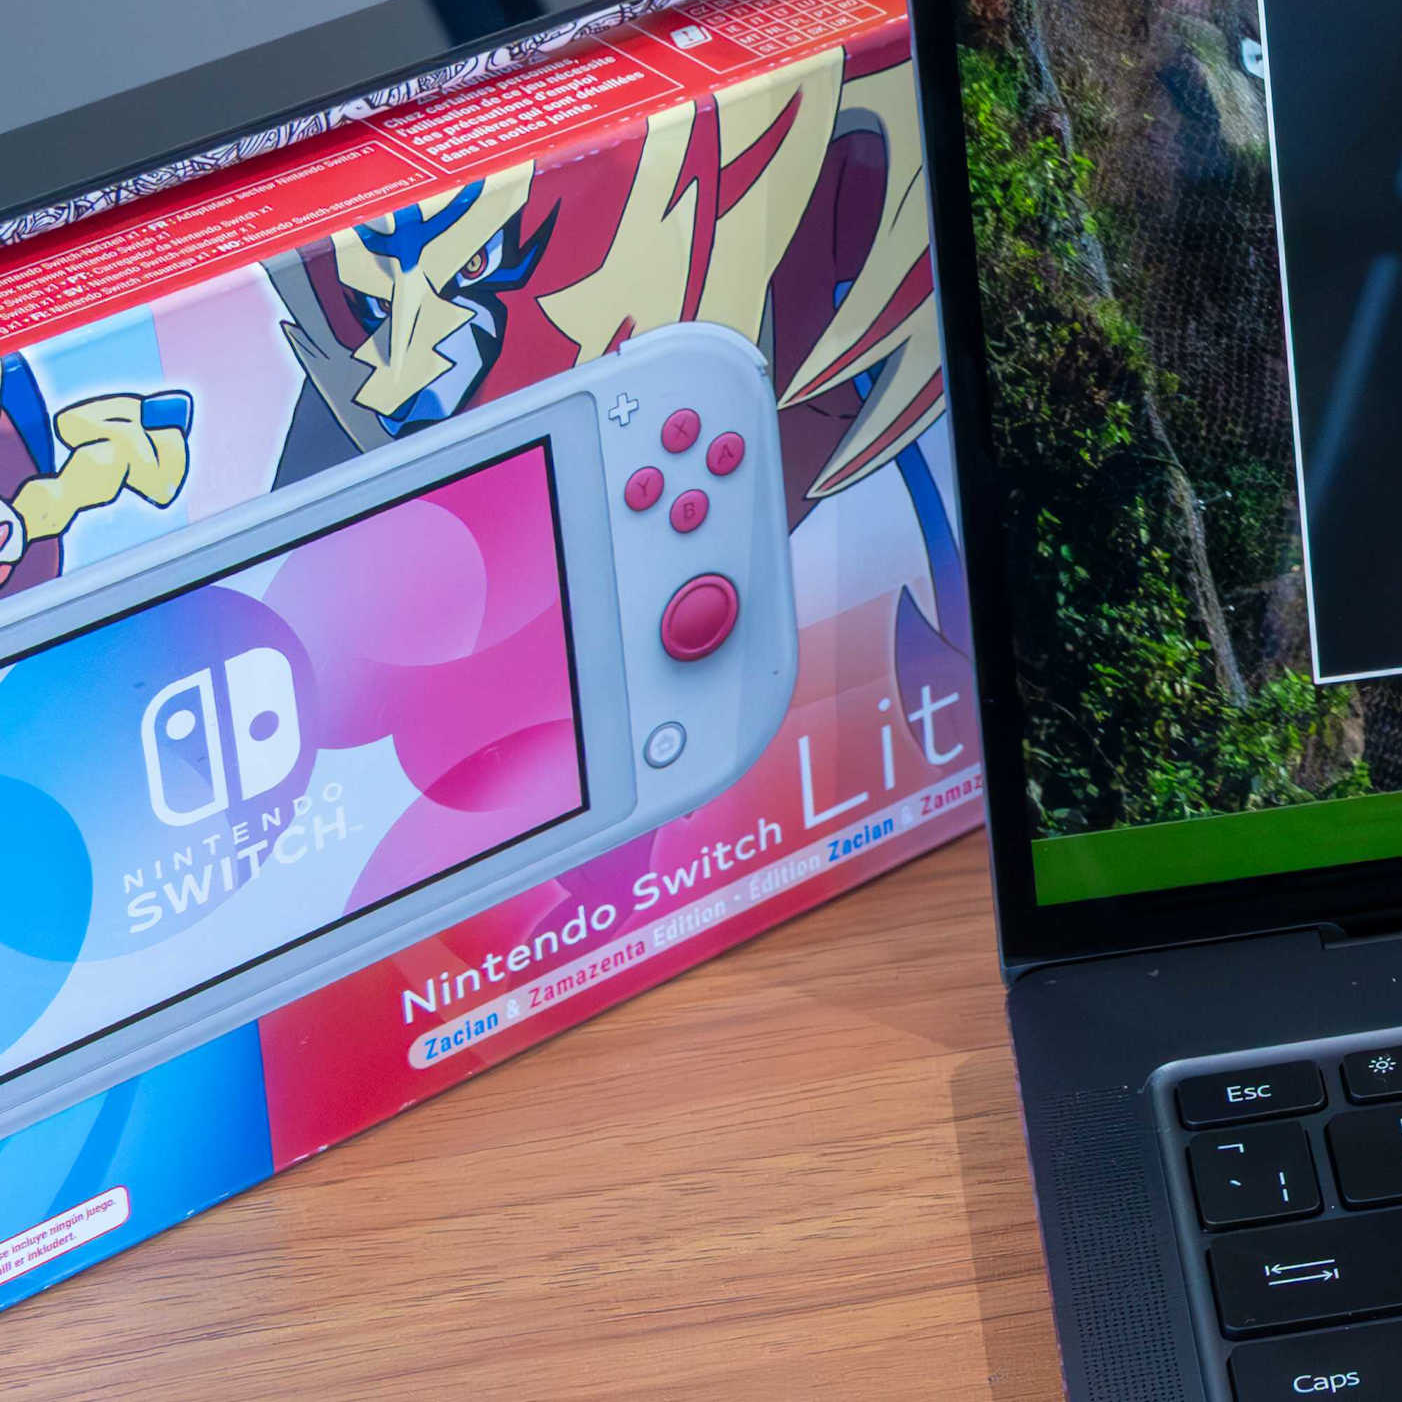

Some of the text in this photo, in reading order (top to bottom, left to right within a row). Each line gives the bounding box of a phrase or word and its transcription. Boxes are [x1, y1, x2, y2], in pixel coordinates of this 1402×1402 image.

[123, 781, 344, 893] NINTENDO
[127, 818, 346, 933] SWITCH
[402, 682, 965, 1024] Nintendo Switch Lit
[424, 1008, 500, 1061] Zacian
[529, 938, 647, 1010] Zamazenta
[652, 896, 727, 946] Edition
[748, 849, 822, 903] Édition
[828, 815, 895, 862] Zacian
[919, 774, 982, 817] Zamaz
[1227, 1085, 1271, 1102] Esc
[1294, 1372, 1359, 1392] Caps
